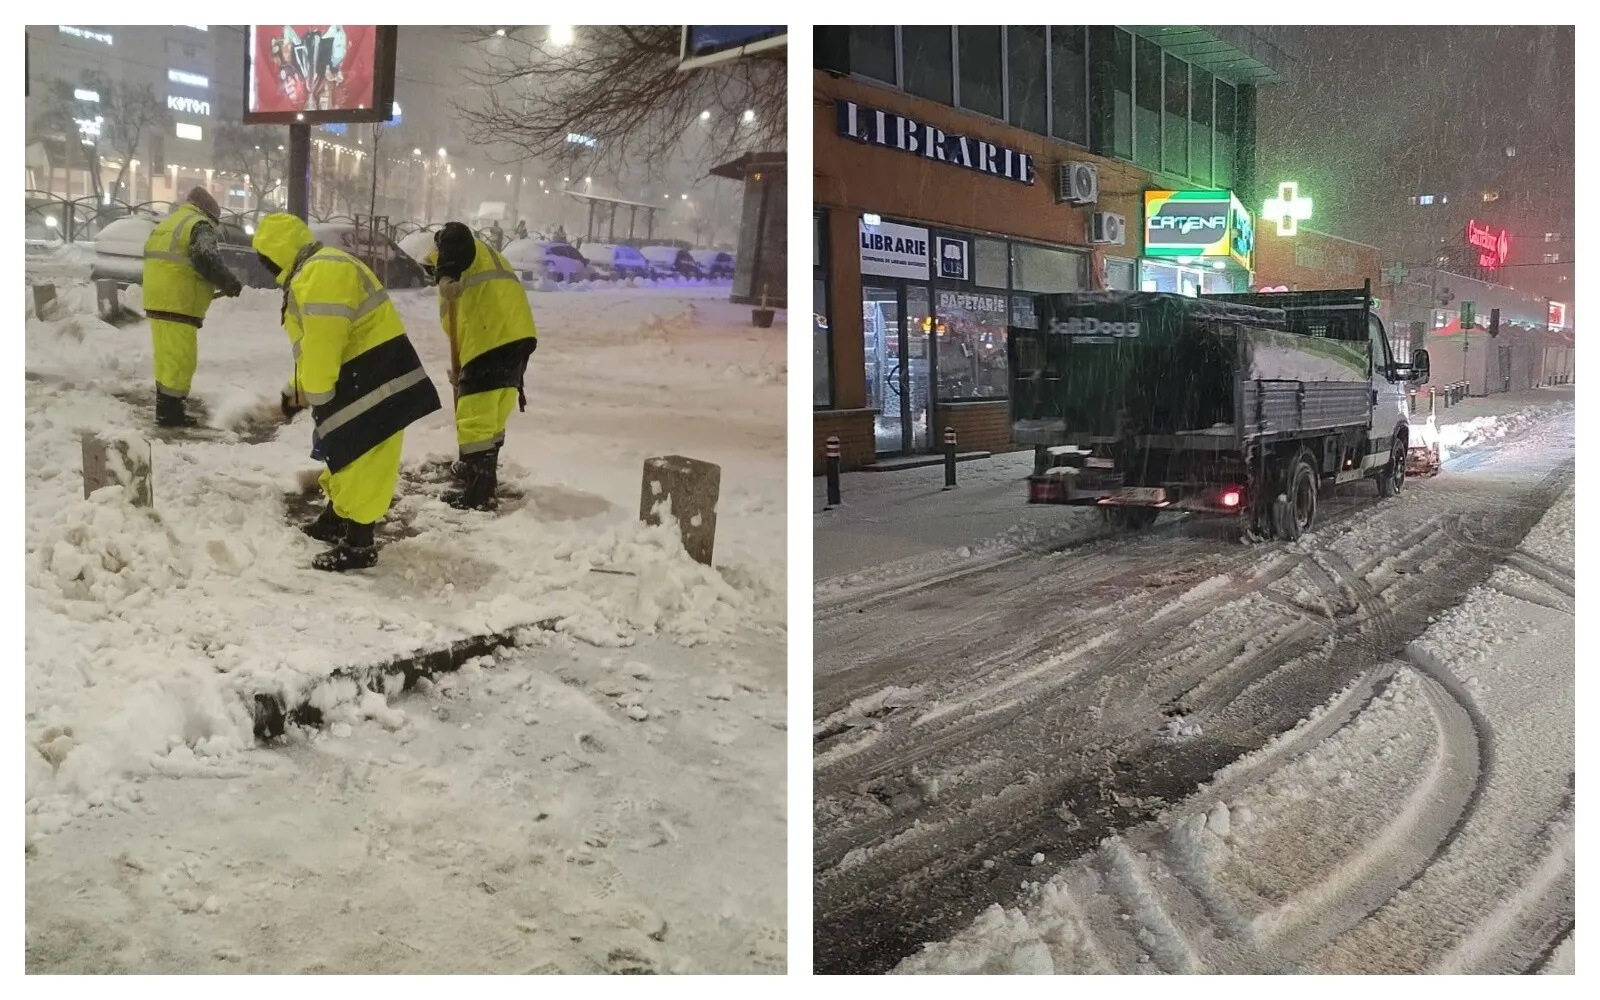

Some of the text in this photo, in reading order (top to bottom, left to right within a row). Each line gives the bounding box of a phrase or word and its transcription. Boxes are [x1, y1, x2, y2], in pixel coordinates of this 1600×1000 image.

[847, 101, 1035, 185] LIBRARIE
[1148, 216, 1226, 234] CATENA
[861, 232, 927, 256] LIBRARIE
[940, 293, 1005, 313] PAPETARIE
